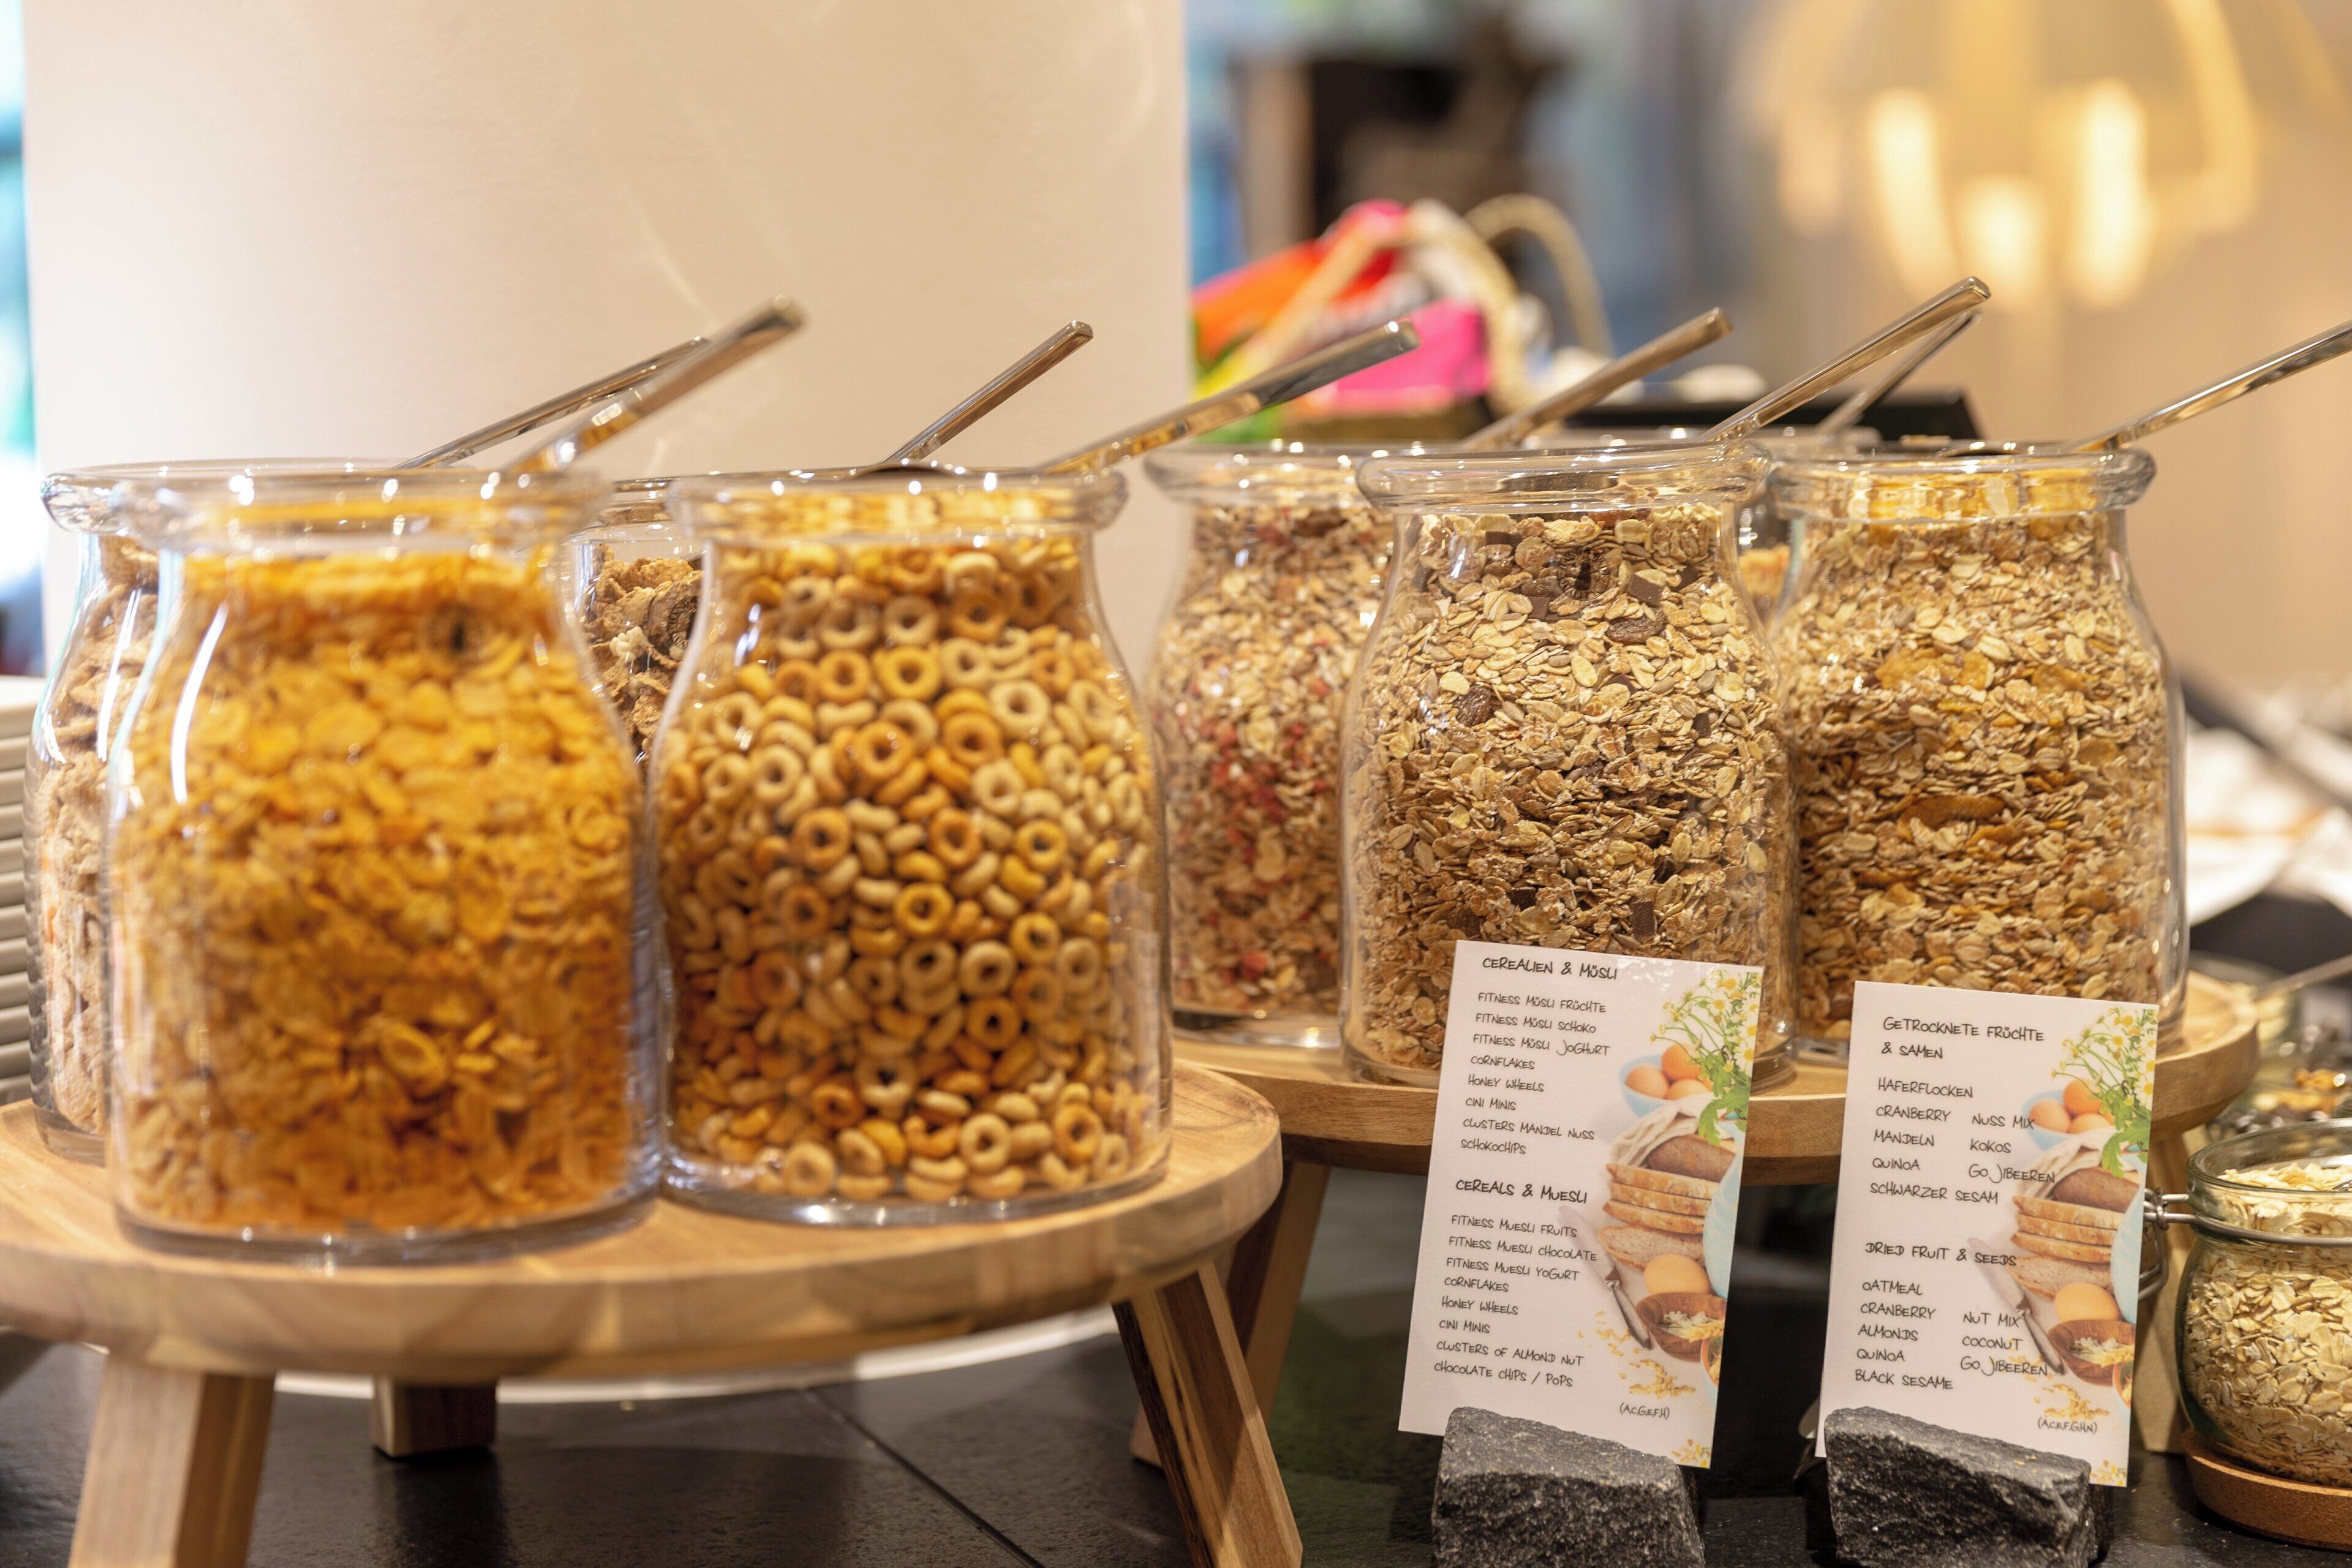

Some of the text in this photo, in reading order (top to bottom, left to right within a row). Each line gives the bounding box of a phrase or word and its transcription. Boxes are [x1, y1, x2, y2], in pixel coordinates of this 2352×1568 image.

[1482, 957, 1618, 980] CEREALIEN & MÜSLI
[1478, 992, 1607, 1012] FITNESS MÜSLI FRÜCHTE
[1476, 1014, 1597, 1033] FITNESS MÜSLI SCHOKO
[1883, 1017, 2045, 1041] GETROCKNETE FRÜCHTE
[1473, 1035, 1611, 1056] FITNESS MÜSLI JOGHURT
[1881, 1042, 1943, 1059] & SAMEN
[1471, 1056, 1536, 1070] CORNFLAKES
[1468, 1074, 1545, 1092] HONEY WHEELS
[1878, 1077, 1973, 1098] HAFERFLOCKEN
[1466, 1098, 1517, 1110] CINI MINIS
[1876, 1105, 1951, 1121] CRANBERRY
[1463, 1118, 1595, 1139] CLUSTERS MANDEL NUSS
[1972, 1114, 2035, 1129] NUSS MIX
[1461, 1139, 1526, 1154] SCHOKOCHIPS
[1874, 1129, 1935, 1147] MANDELN
[1970, 1139, 2011, 1153] KOKOS
[1872, 1158, 1920, 1171] QUINOA
[1455, 1179, 1588, 1204] CEREALS & MUESLI
[1870, 1181, 1999, 1204] SCHWARZER SESAM
[1452, 1215, 1578, 1237] FITNESS MUESLI FRUITS
[1449, 1237, 1597, 1261] FITNESS MUESLI CHOCOLATE
[1865, 1242, 2018, 1266] DRIED FRUIT & SEEDS
[1447, 1258, 1580, 1281] FITNESS MUESLI YOGURT
[1444, 1277, 1509, 1292] CORNFLAKES
[1862, 1280, 1924, 1296] OATMEAL
[1442, 1296, 1519, 1314] HONEY WHEELS
[1860, 1303, 1936, 1319] CRANBERRY
[1439, 1320, 1490, 1333] CINI MINIS
[1963, 1311, 2021, 1328] NUT MIX
[1858, 1325, 1919, 1341] ALMONDS
[1962, 1336, 2024, 1351] COCONUT
[1436, 1341, 1585, 1366] CLUSTERS OF ALMOND NUT
[1856, 1349, 1905, 1362] QUINOA
[1434, 1360, 1493, 1378] CHOCOLATE
[1499, 1368, 1527, 1382] CHIPS
[1546, 1373, 1573, 1387] POPS
[1855, 1370, 1954, 1390] BLACK SESAME
